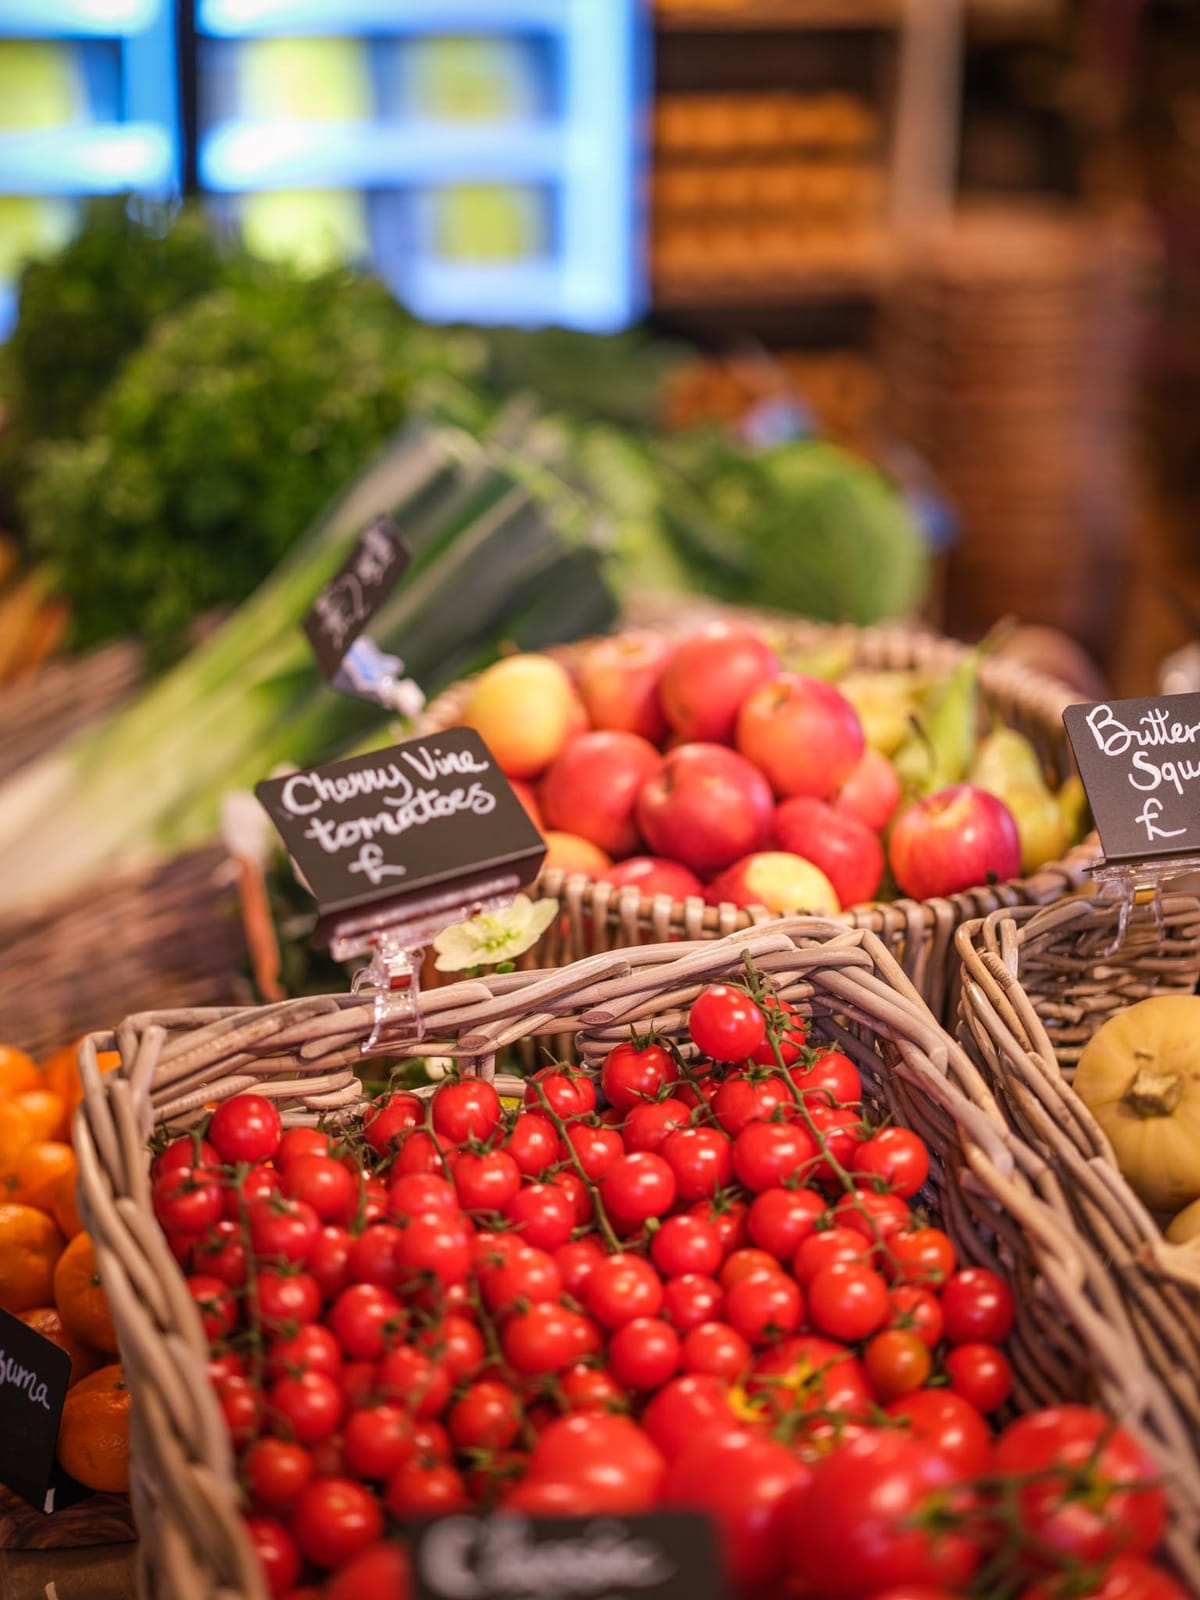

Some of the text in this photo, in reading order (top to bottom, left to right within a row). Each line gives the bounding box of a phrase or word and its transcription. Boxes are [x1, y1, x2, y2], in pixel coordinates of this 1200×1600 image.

[281, 746, 490, 816] Cherry Vine
[1128, 751, 1200, 795] Squ
[304, 782, 496, 852] tomatoes
[1135, 797, 1187, 841] £
[348, 843, 406, 885] £
